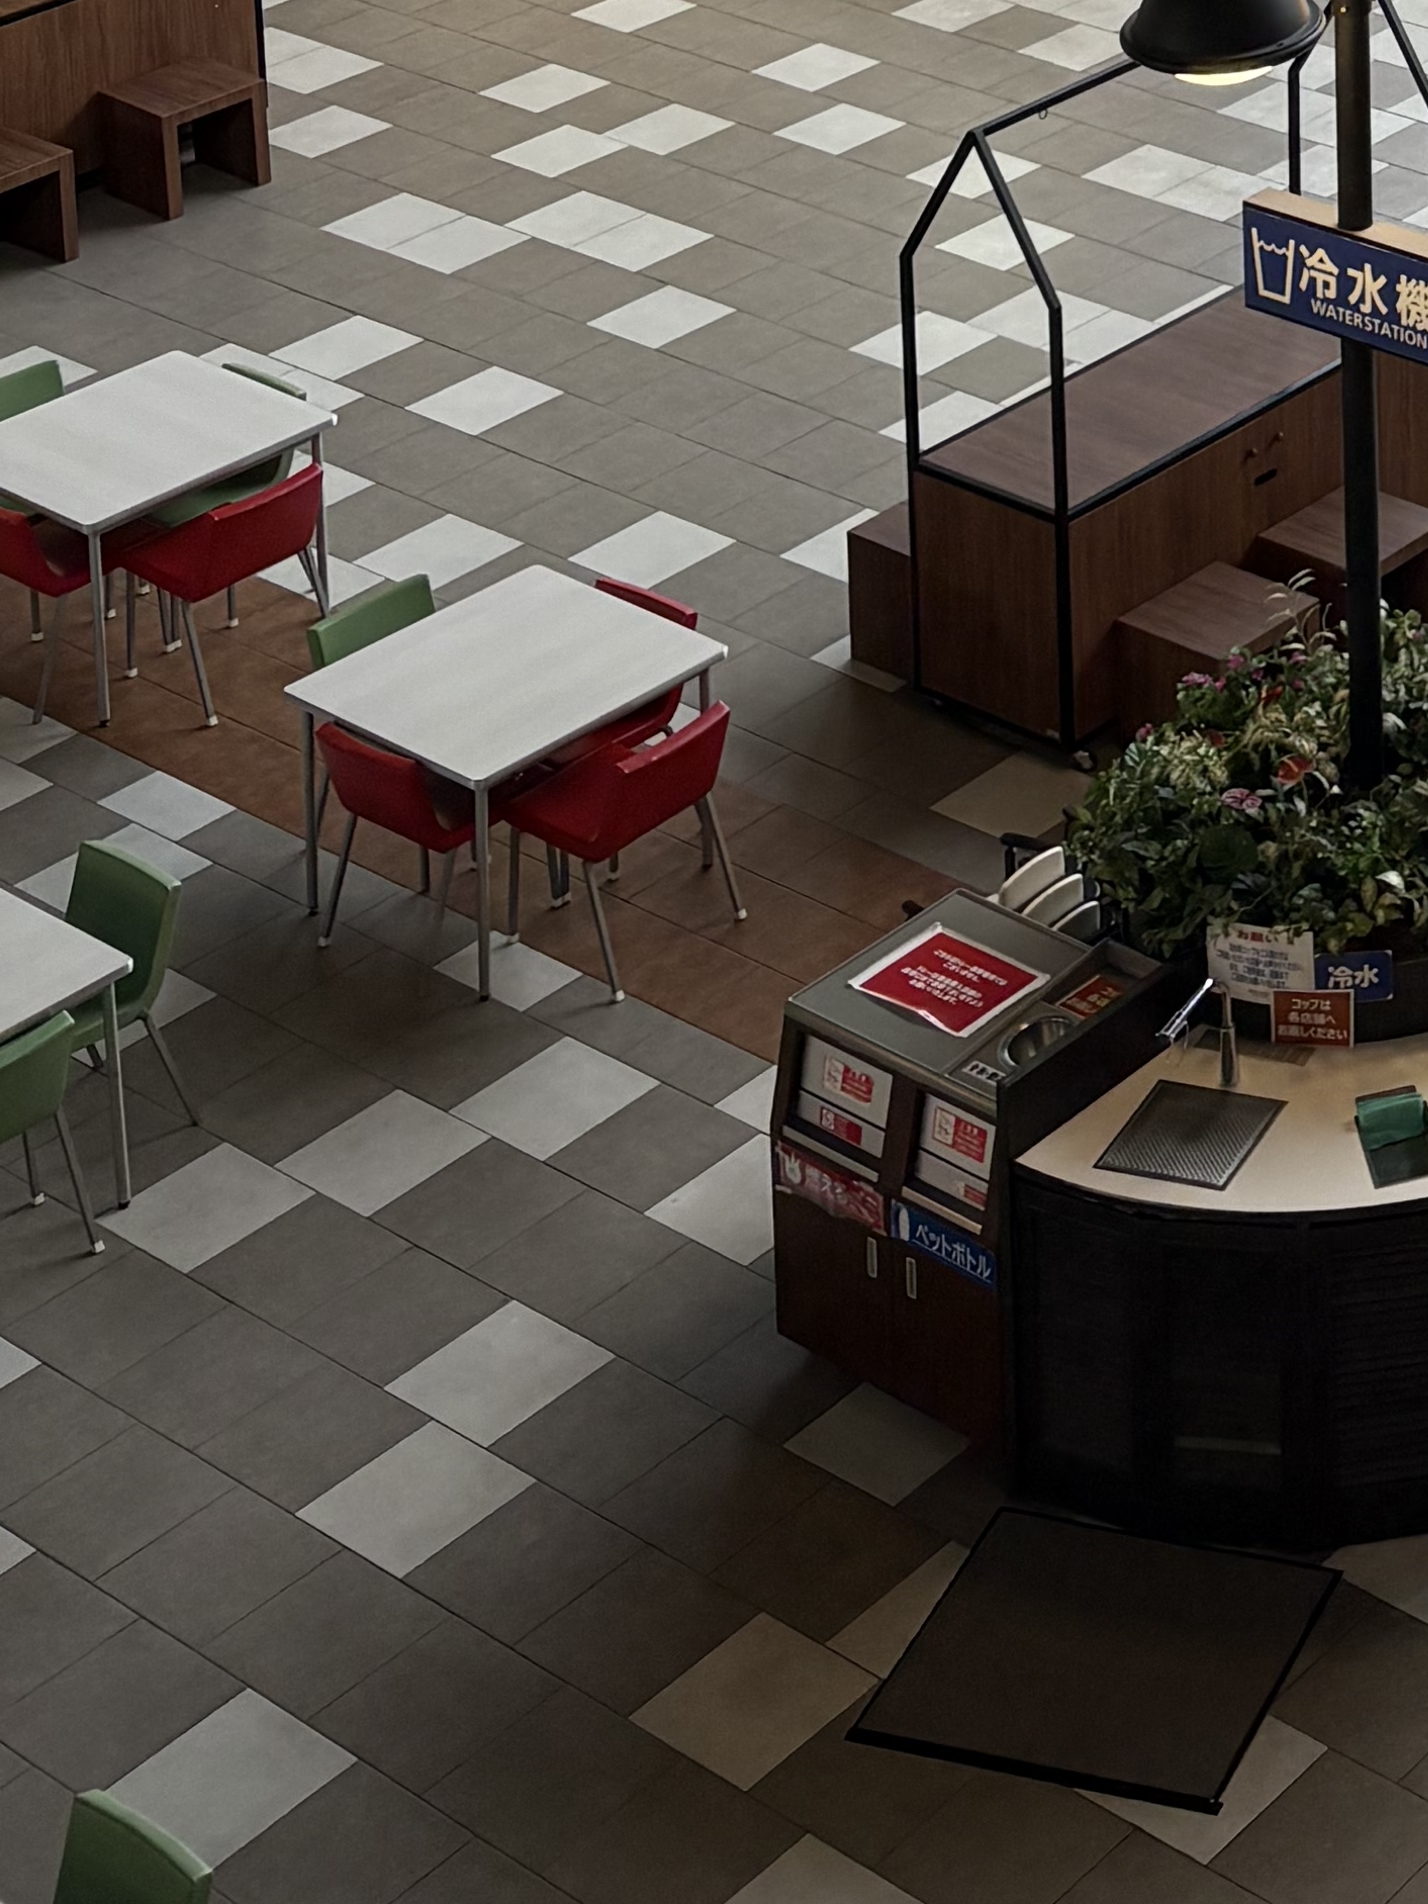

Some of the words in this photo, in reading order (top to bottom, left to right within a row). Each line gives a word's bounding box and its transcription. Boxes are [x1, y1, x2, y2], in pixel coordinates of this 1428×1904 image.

[1310, 297, 1428, 350] WATERSTATION
[1327, 963, 1380, 989] 冷水
[1291, 997, 1332, 1011] コップは
[915, 1223, 992, 1280] ペットボトル
